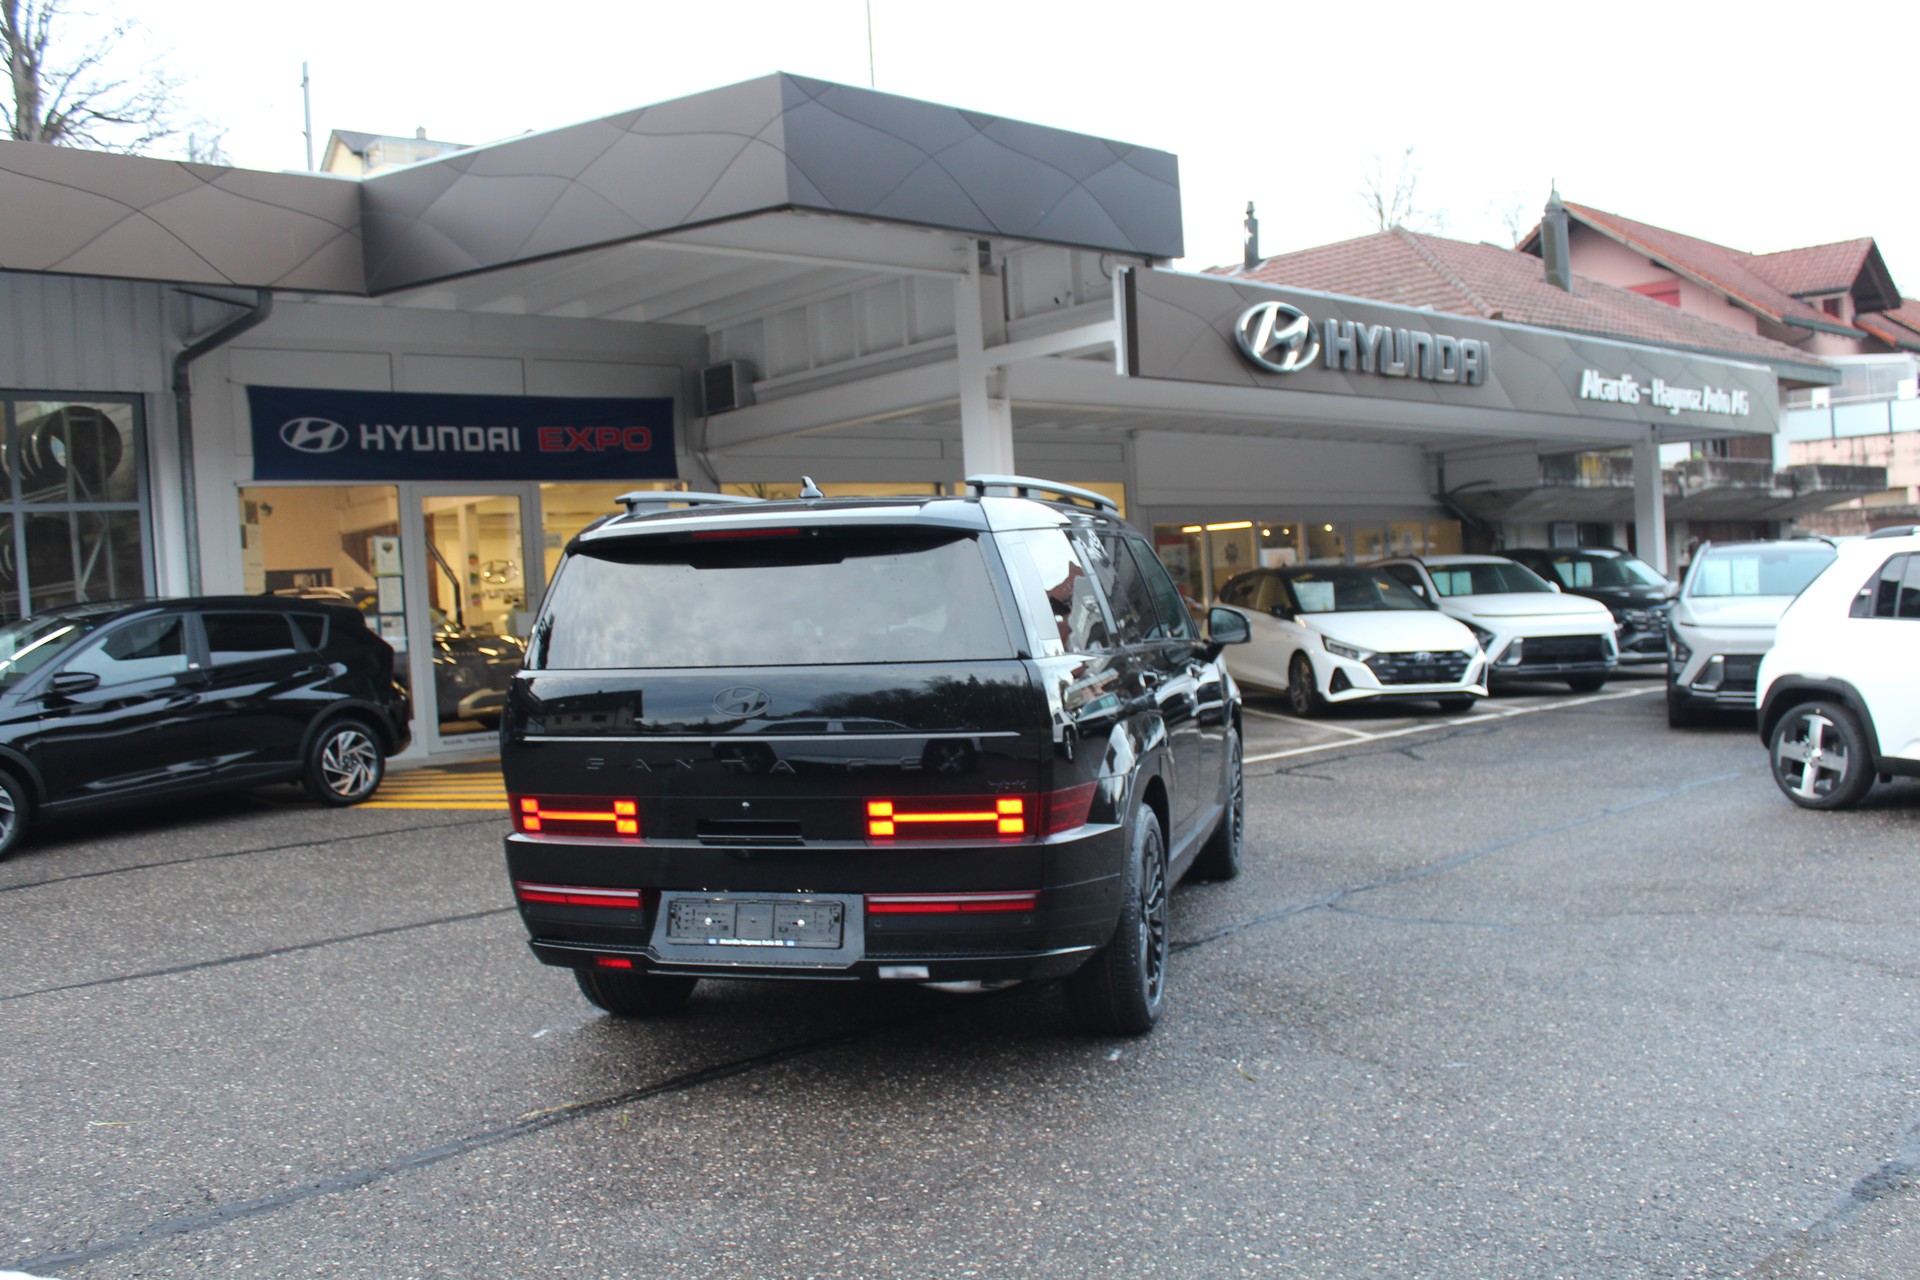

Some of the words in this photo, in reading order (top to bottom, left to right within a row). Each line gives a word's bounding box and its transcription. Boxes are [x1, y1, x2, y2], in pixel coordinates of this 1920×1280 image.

[1324, 318, 1490, 386] HYUNDAI
[1580, 369, 1640, 404] Alcardis
[1702, 385, 1731, 415] Auto
[360, 424, 521, 452] HYUNDAI
[538, 426, 652, 452] EXPO
